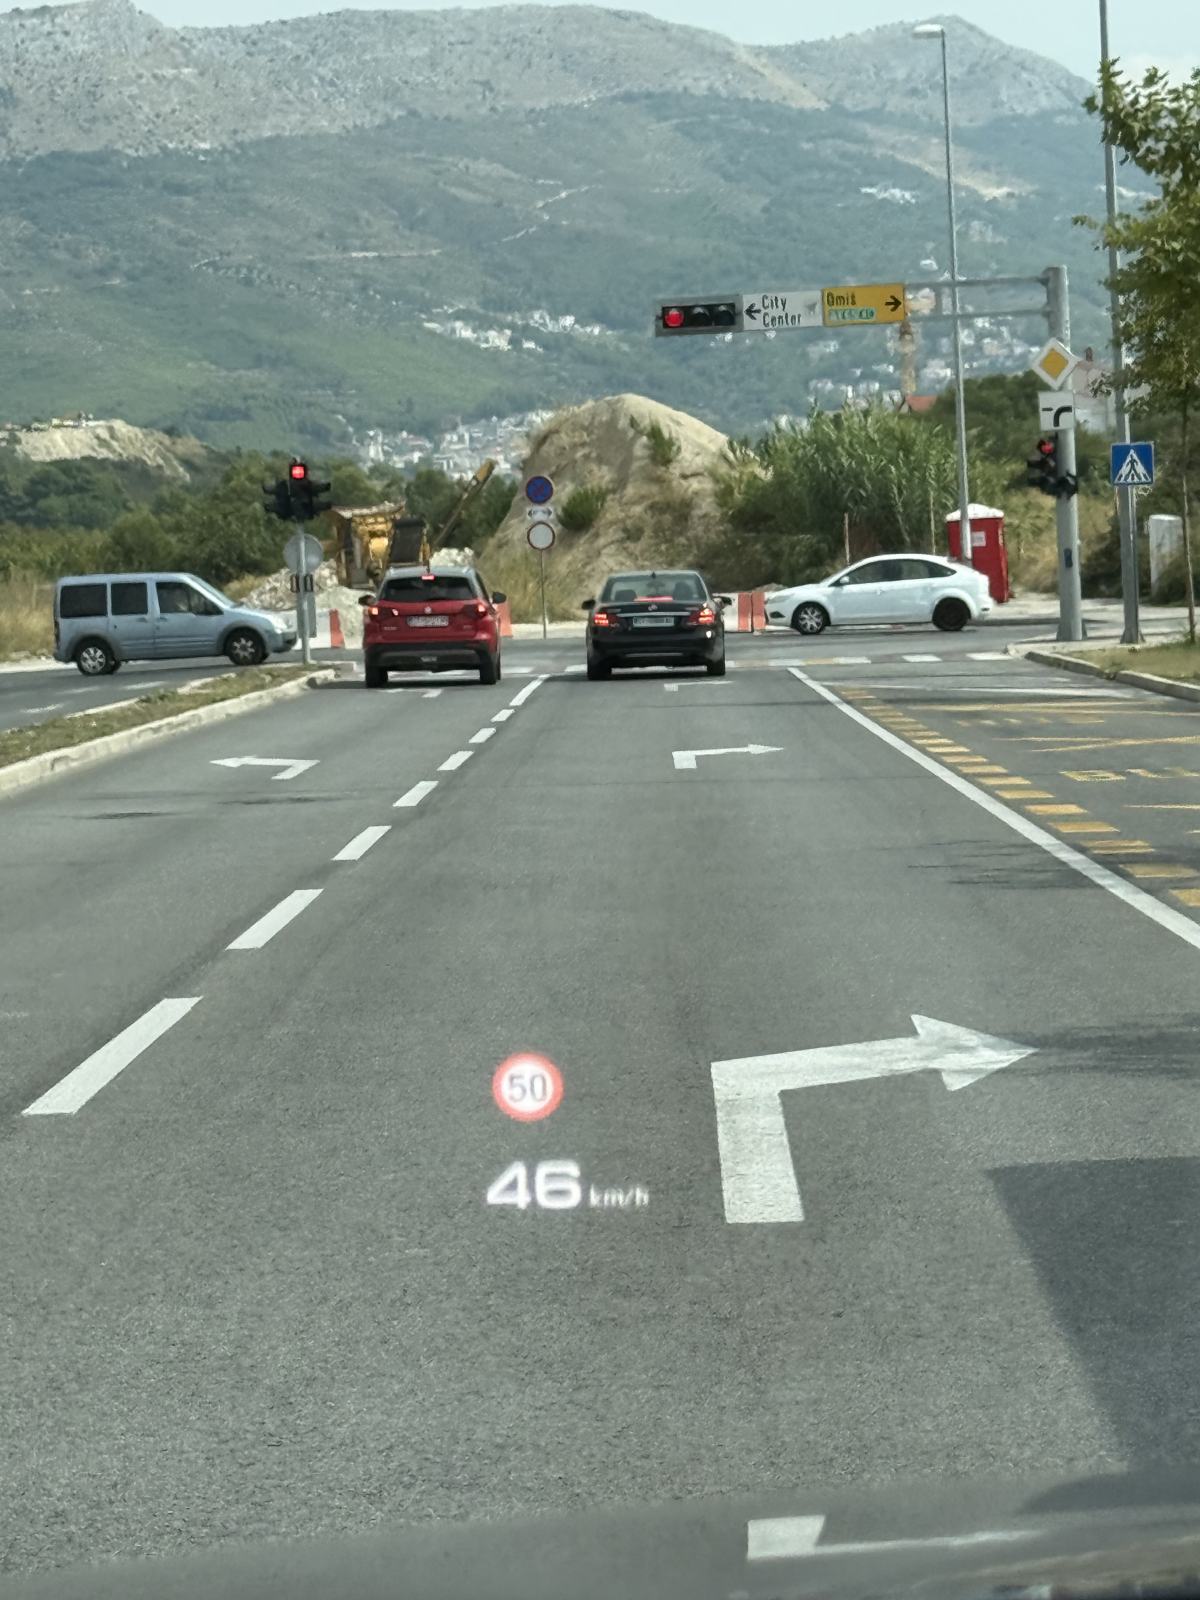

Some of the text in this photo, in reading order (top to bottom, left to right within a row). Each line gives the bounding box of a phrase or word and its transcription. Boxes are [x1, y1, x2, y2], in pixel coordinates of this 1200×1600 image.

[761, 294, 787, 312] City
[762, 312, 802, 327] Center
[507, 1072, 547, 1103] 50
[486, 1159, 650, 1209] 46 km/h
